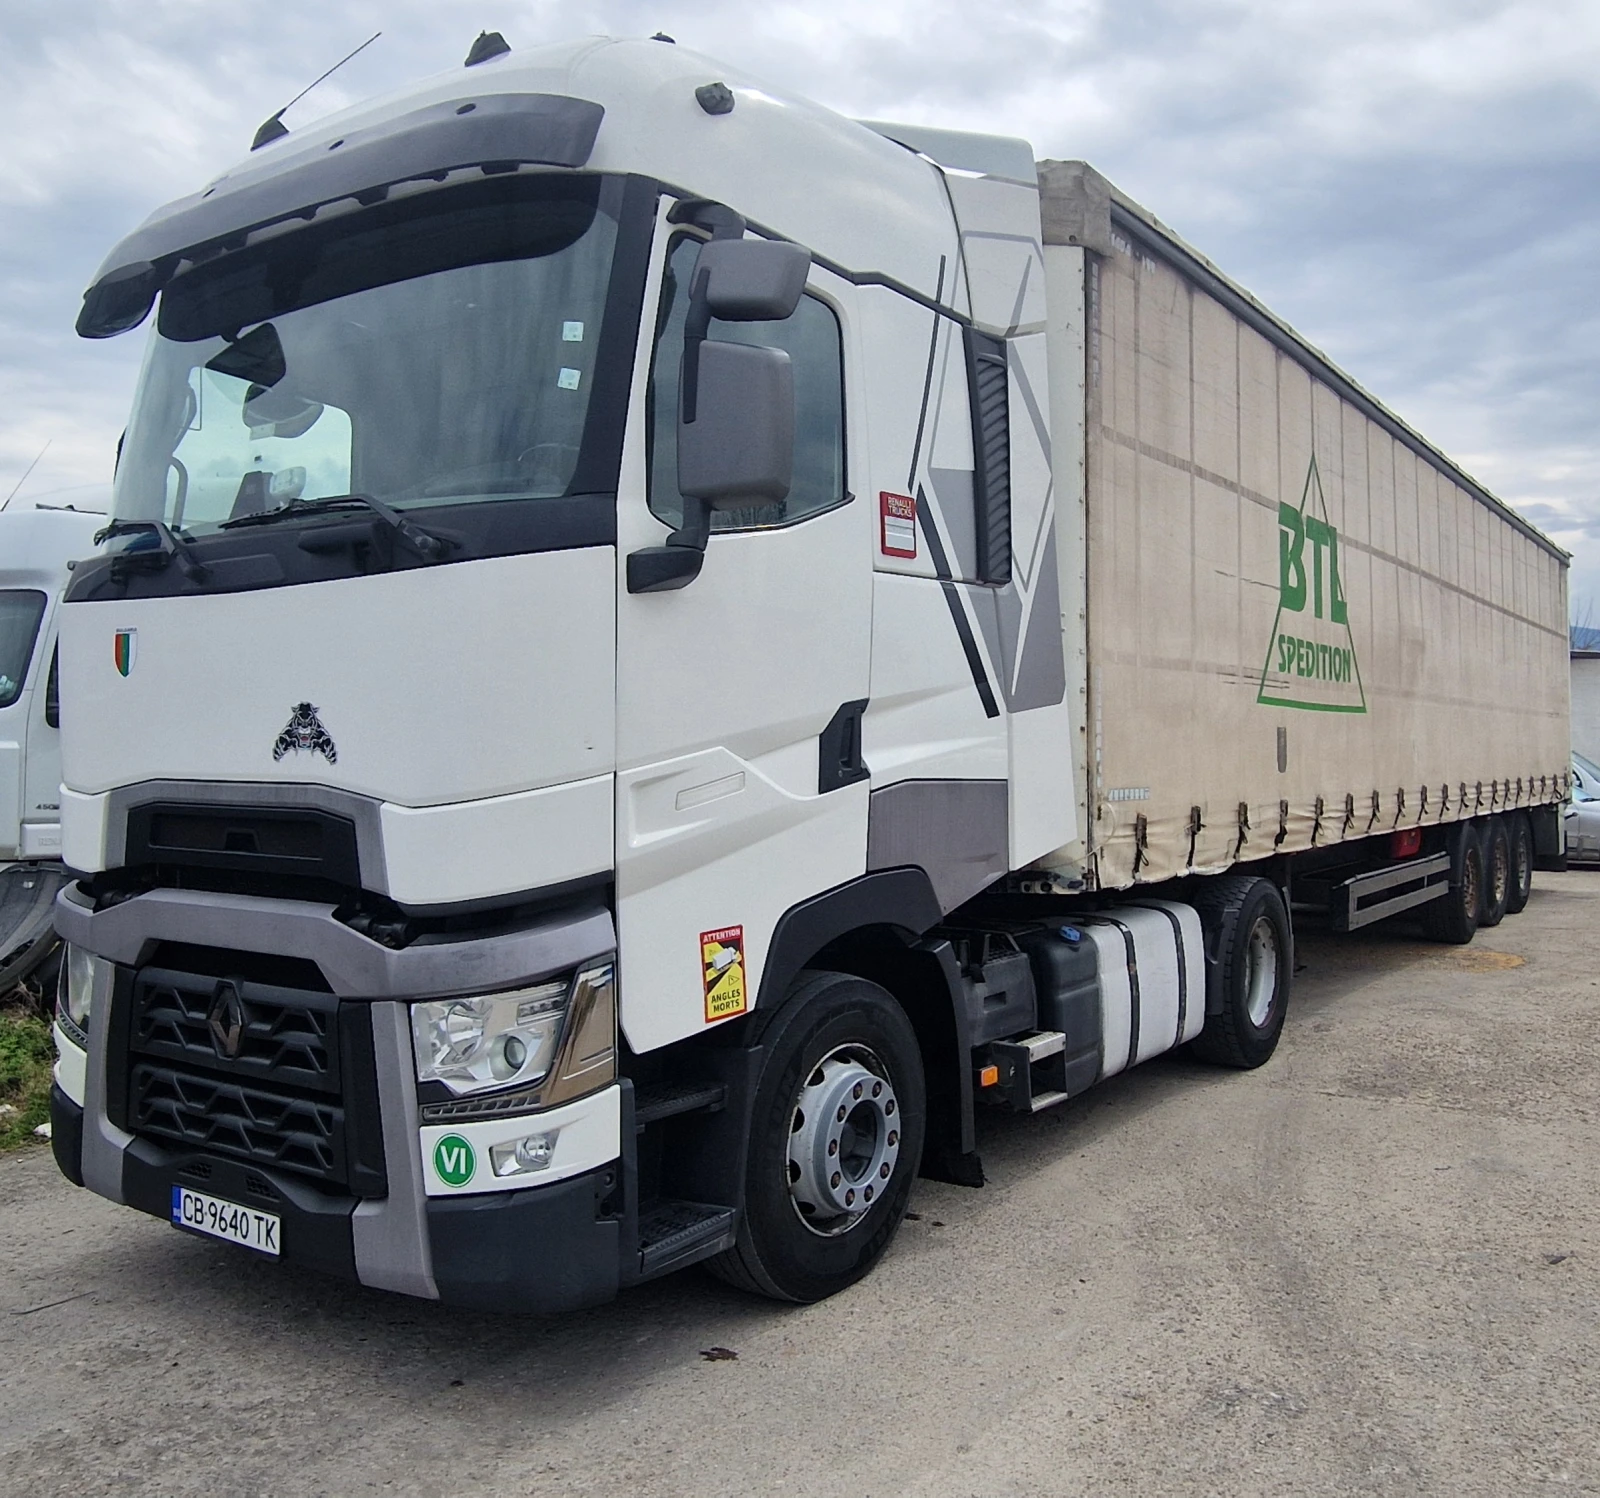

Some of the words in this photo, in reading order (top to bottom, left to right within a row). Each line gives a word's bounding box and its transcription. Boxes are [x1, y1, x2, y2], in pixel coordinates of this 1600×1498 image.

[889, 505, 912, 517] TRUCKS
[1278, 501, 1347, 624] BTL
[1278, 634, 1351, 682] SPEDITION
[703, 927, 740, 943] ATTENTION
[711, 989, 740, 1003] ANGLES
[713, 999, 740, 1013] MORTS
[440, 1145, 466, 1175] VI
[183, 1194, 204, 1225] CB
[208, 1201, 249, 1239] 9640
[254, 1215, 276, 1249] TK
